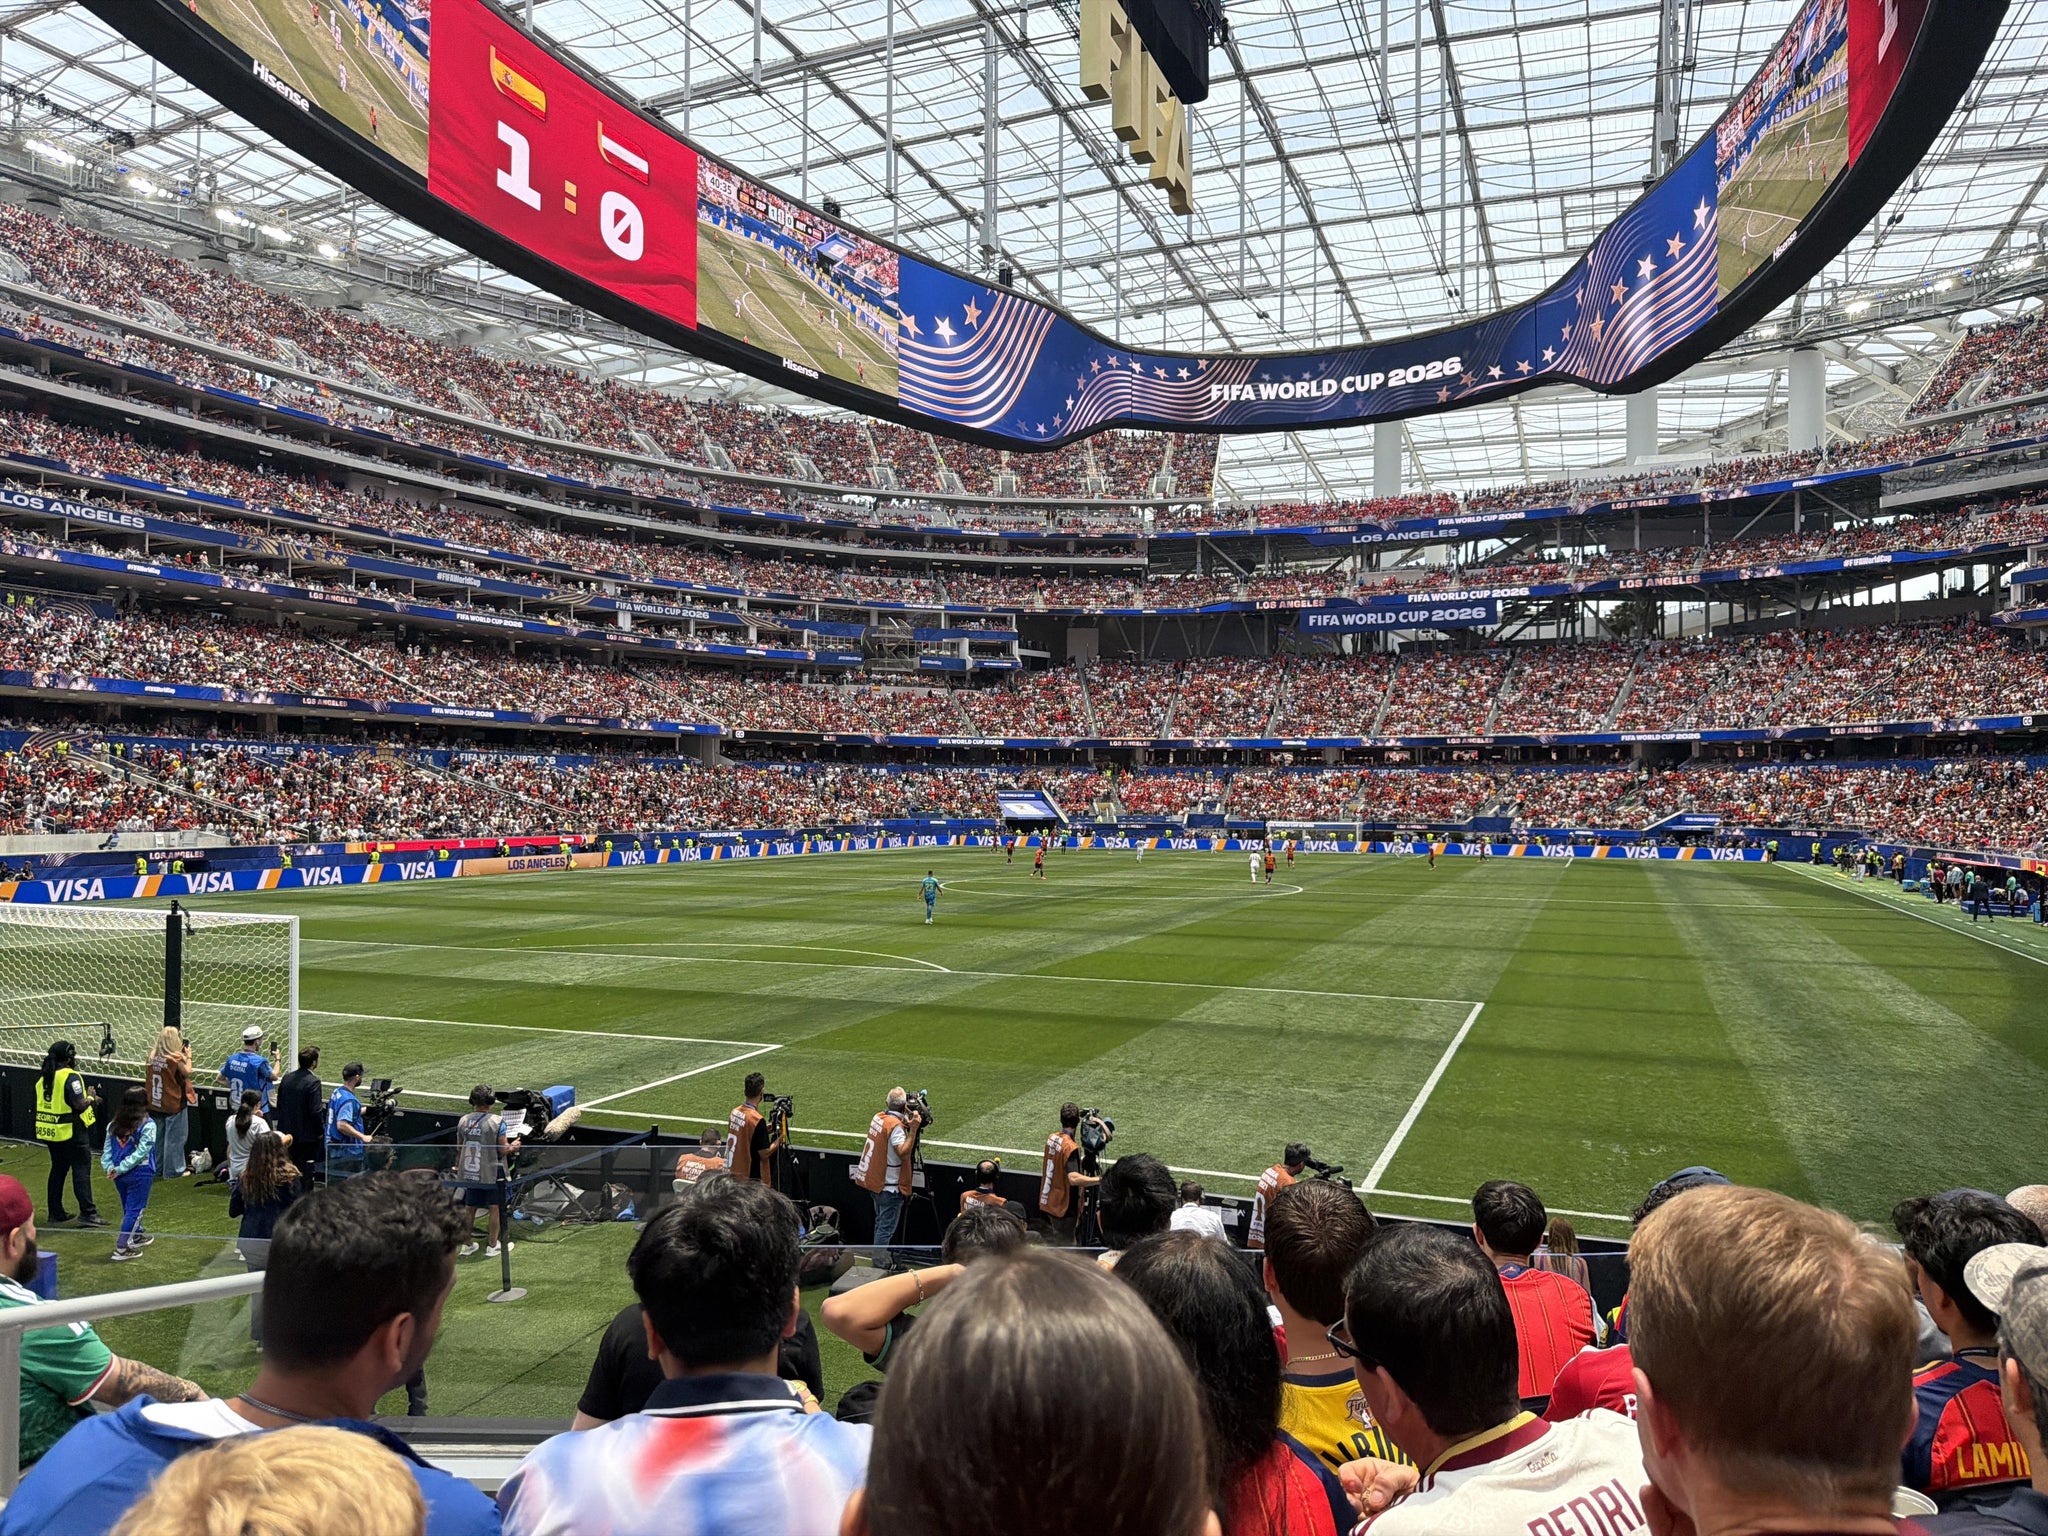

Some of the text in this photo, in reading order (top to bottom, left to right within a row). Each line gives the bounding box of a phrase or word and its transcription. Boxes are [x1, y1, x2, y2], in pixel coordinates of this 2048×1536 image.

[252, 59, 310, 112] Hisense
[1080, 0, 1193, 215] FIFA
[497, 120, 541, 212] 1
[600, 190, 644, 262] 0
[710, 176, 733, 195] 40:35
[1772, 230, 1798, 262] Hisense
[782, 357, 819, 379] Hisense
[1211, 356, 1462, 400] FIFA WORLD CUP 2026
[0, 492, 145, 529] LOS ANGELES
[1611, 498, 1669, 510] LOS ANGELES
[1438, 518, 1455, 526] FIFA
[1455, 515, 1480, 524] WORLD
[1498, 512, 1526, 520] 2026
[1323, 525, 1358, 533] ANGELES
[1352, 528, 1459, 543] LOS ANGELES
[436, 571, 481, 588] #FIFAWorldCup
[1619, 574, 1700, 589] LOS ANGELES
[309, 591, 324, 600] LOS
[1407, 587, 1530, 603] FIFA WORLD CUP 2026
[616, 601, 710, 619] FIFA WORLD CUP 2026
[1256, 599, 1326, 610] LOS ANGELES
[470, 614, 492, 623] WORLD
[492, 617, 503, 625] CUP
[1308, 607, 1487, 626] FIFA WORLD CUP 2026
[444, 708, 464, 716] WORLD
[817, 841, 834, 853] VISA
[854, 838, 870, 850] VISA
[888, 836, 902, 848] VISA
[917, 835, 937, 846] VISA
[977, 836, 1002, 847] VISA
[1170, 838, 1198, 850] VISA
[1238, 839, 1265, 851] VISA
[1309, 840, 1339, 852] VISA
[1382, 841, 1414, 854] VSA
[149, 851, 205, 860] LOS ANGELES
[678, 848, 701, 862] VISA
[730, 845, 750, 858] VISA
[776, 843, 795, 856] VISA
[1460, 843, 1493, 856] VISA
[1541, 844, 1575, 858] VISA
[1625, 846, 1659, 859] VISA
[1709, 848, 1744, 861] VISA
[507, 857, 566, 871] LOS ANGELES
[620, 850, 646, 866] VISA
[298, 865, 344, 887] VISA
[398, 862, 436, 881] VISA
[186, 871, 235, 894] VISA
[42, 878, 105, 903] VISA
[230, 1065, 247, 1074] DIGITAL
